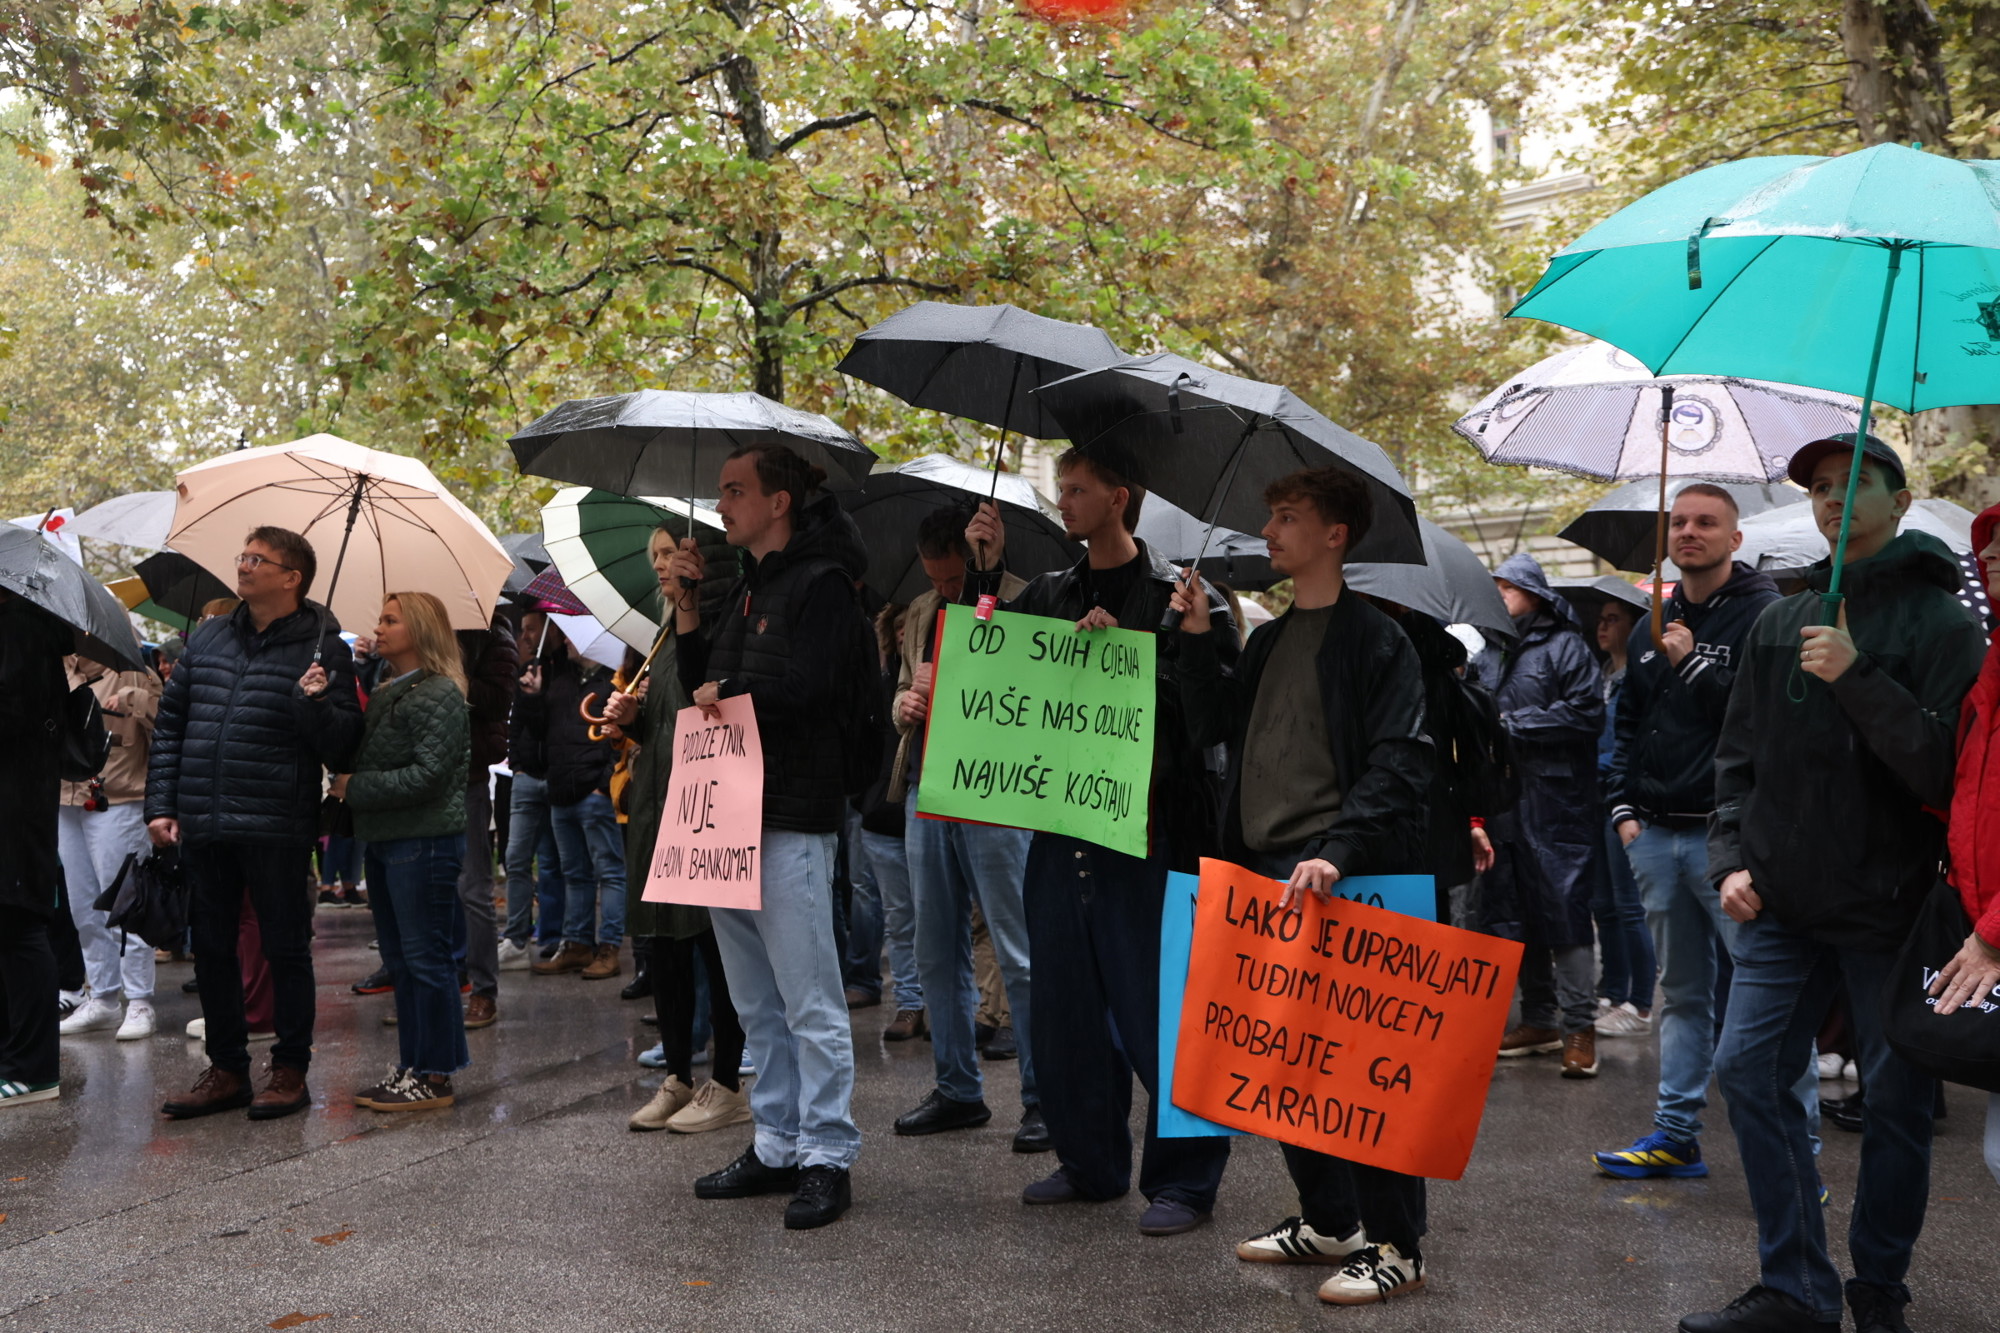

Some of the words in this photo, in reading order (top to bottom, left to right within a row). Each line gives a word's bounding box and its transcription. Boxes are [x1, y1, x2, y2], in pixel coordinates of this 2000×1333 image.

[968, 623, 1006, 655] OD
[1028, 630, 1091, 668] SVIH
[1101, 642, 1140, 680] CIJENA
[681, 723, 746, 765] PODUZETNIK
[961, 685, 1032, 727] VAŠE
[1042, 699, 1089, 733] NAS
[1095, 704, 1143, 743] ODLUKE
[677, 780, 718, 834] NIJE
[952, 754, 1054, 799] NAJVIŠE
[1064, 769, 1132, 822] KOŠTAJU
[654, 845, 685, 879] VLADIN
[688, 846, 757, 882] BANKOMAT
[1225, 885, 1303, 943] LAKO
[1310, 917, 1340, 959] JE
[1342, 926, 1500, 1000] UPRAVLJATI
[1236, 953, 1320, 1004] TUĐIM
[1326, 979, 1444, 1042] NOVCEM
[1204, 1001, 1343, 1076] PROBAJTE
[1368, 1057, 1412, 1094] GA
[1225, 1072, 1386, 1148] ZARADITI
